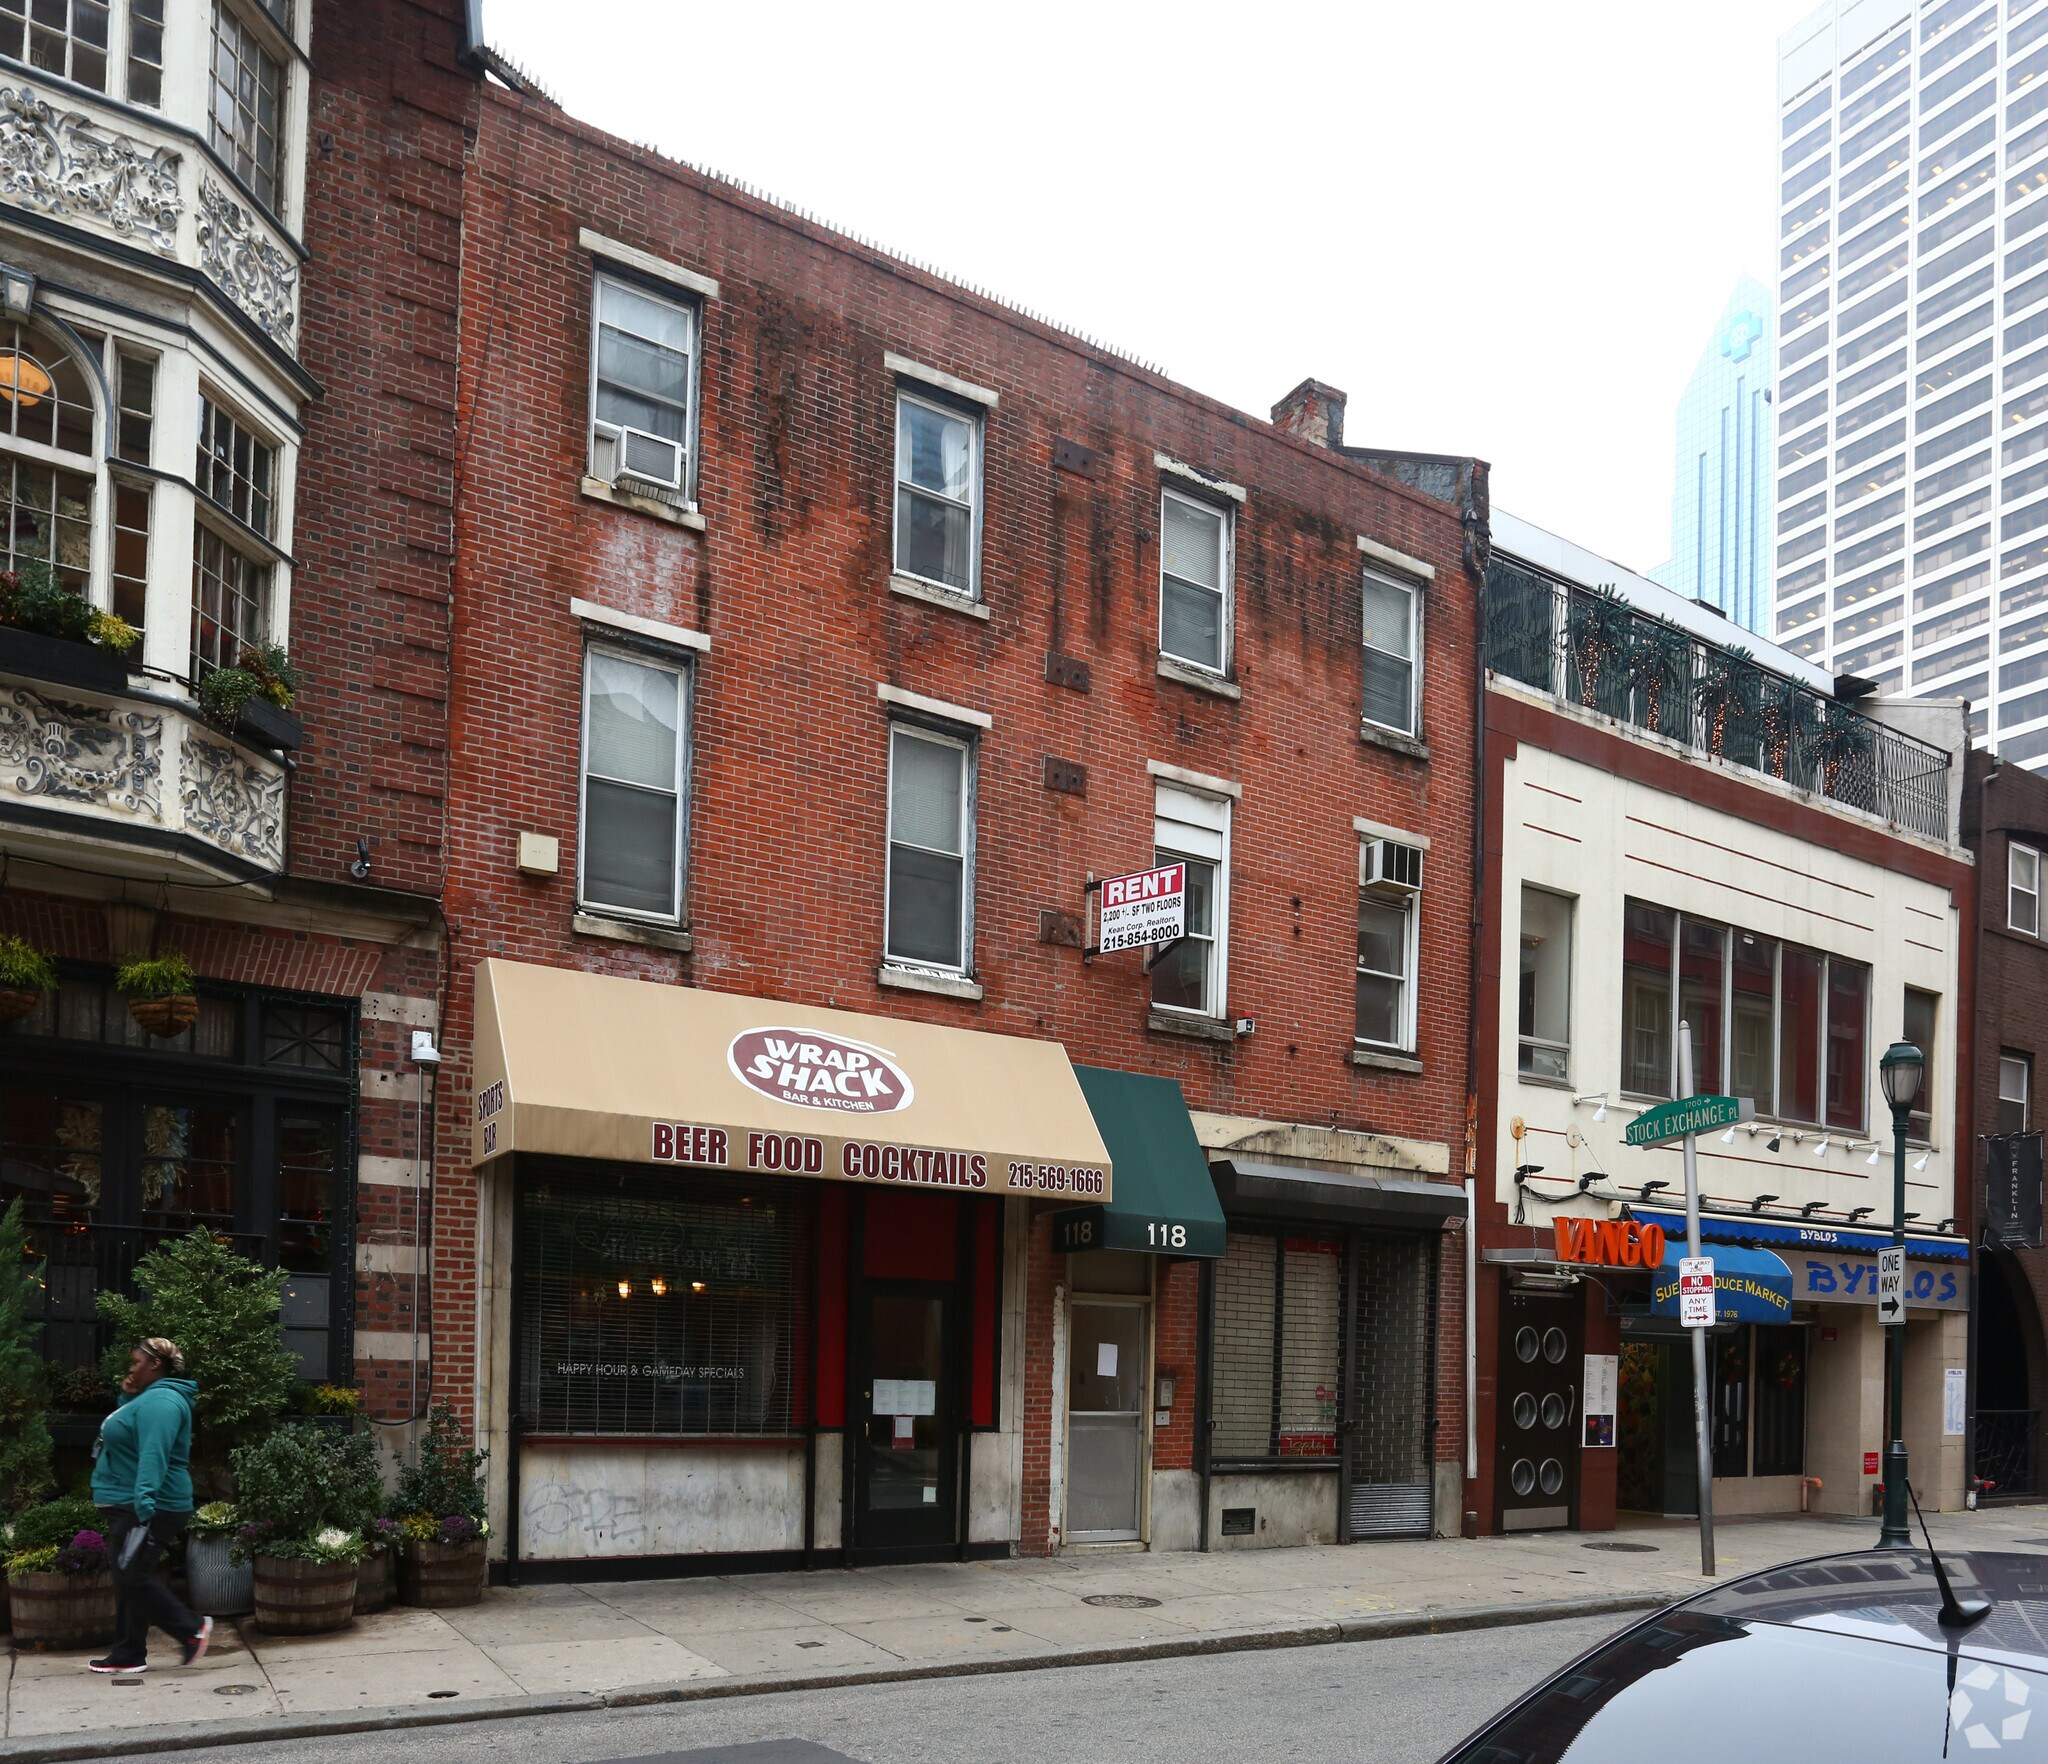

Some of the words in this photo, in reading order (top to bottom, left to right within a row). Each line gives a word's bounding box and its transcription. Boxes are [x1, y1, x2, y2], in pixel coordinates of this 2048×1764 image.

[1108, 869, 1177, 905] RENT
[1103, 909, 1120, 923] 2,200
[1131, 904, 1140, 916] SF
[1141, 901, 1155, 914] TWO
[1157, 897, 1181, 911] FLOORS
[1127, 923, 1145, 931] Corp.
[1147, 916, 1175, 927] Realtors
[1104, 924, 1179, 950] 215-854-8000
[764, 1037, 870, 1072] WRAP
[746, 1054, 893, 1097] SHACK
[478, 1079, 503, 1123] SPORTS
[782, 1090, 810, 1104] BAR
[812, 1096, 822, 1106] &
[824, 1097, 875, 1110] KITCHEN
[1685, 1099, 1702, 1110] 1700
[1626, 1119, 1661, 1144] STOCK
[1664, 1104, 1726, 1136] EXCHANGE
[1728, 1106, 1739, 1120] PL
[483, 1121, 497, 1157] BAR
[652, 1122, 728, 1166] BEER
[748, 1132, 823, 1174] FOOD
[842, 1141, 987, 1189] COCKTAILS
[1007, 1161, 1104, 1194] 215-569-1666
[1065, 1221, 1092, 1246] 118
[1147, 1222, 1187, 1248] 118
[1552, 1216, 1665, 1269] VANGO
[1800, 1229, 1838, 1243] BYBLOS
[1882, 1254, 1900, 1273] ONE
[1682, 1286, 1713, 1294] STOPPING
[1690, 1276, 1703, 1287] NO
[1881, 1275, 1900, 1293] WAY
[1745, 1279, 1790, 1311] MARKET
[1723, 1310, 1738, 1318] 1976
[557, 1362, 593, 1375] HAPPY
[595, 1363, 627, 1376] HOUR
[631, 1365, 639, 1376] &
[642, 1365, 696, 1378] GAMEDAY
[698, 1366, 744, 1379] SPECIALS
